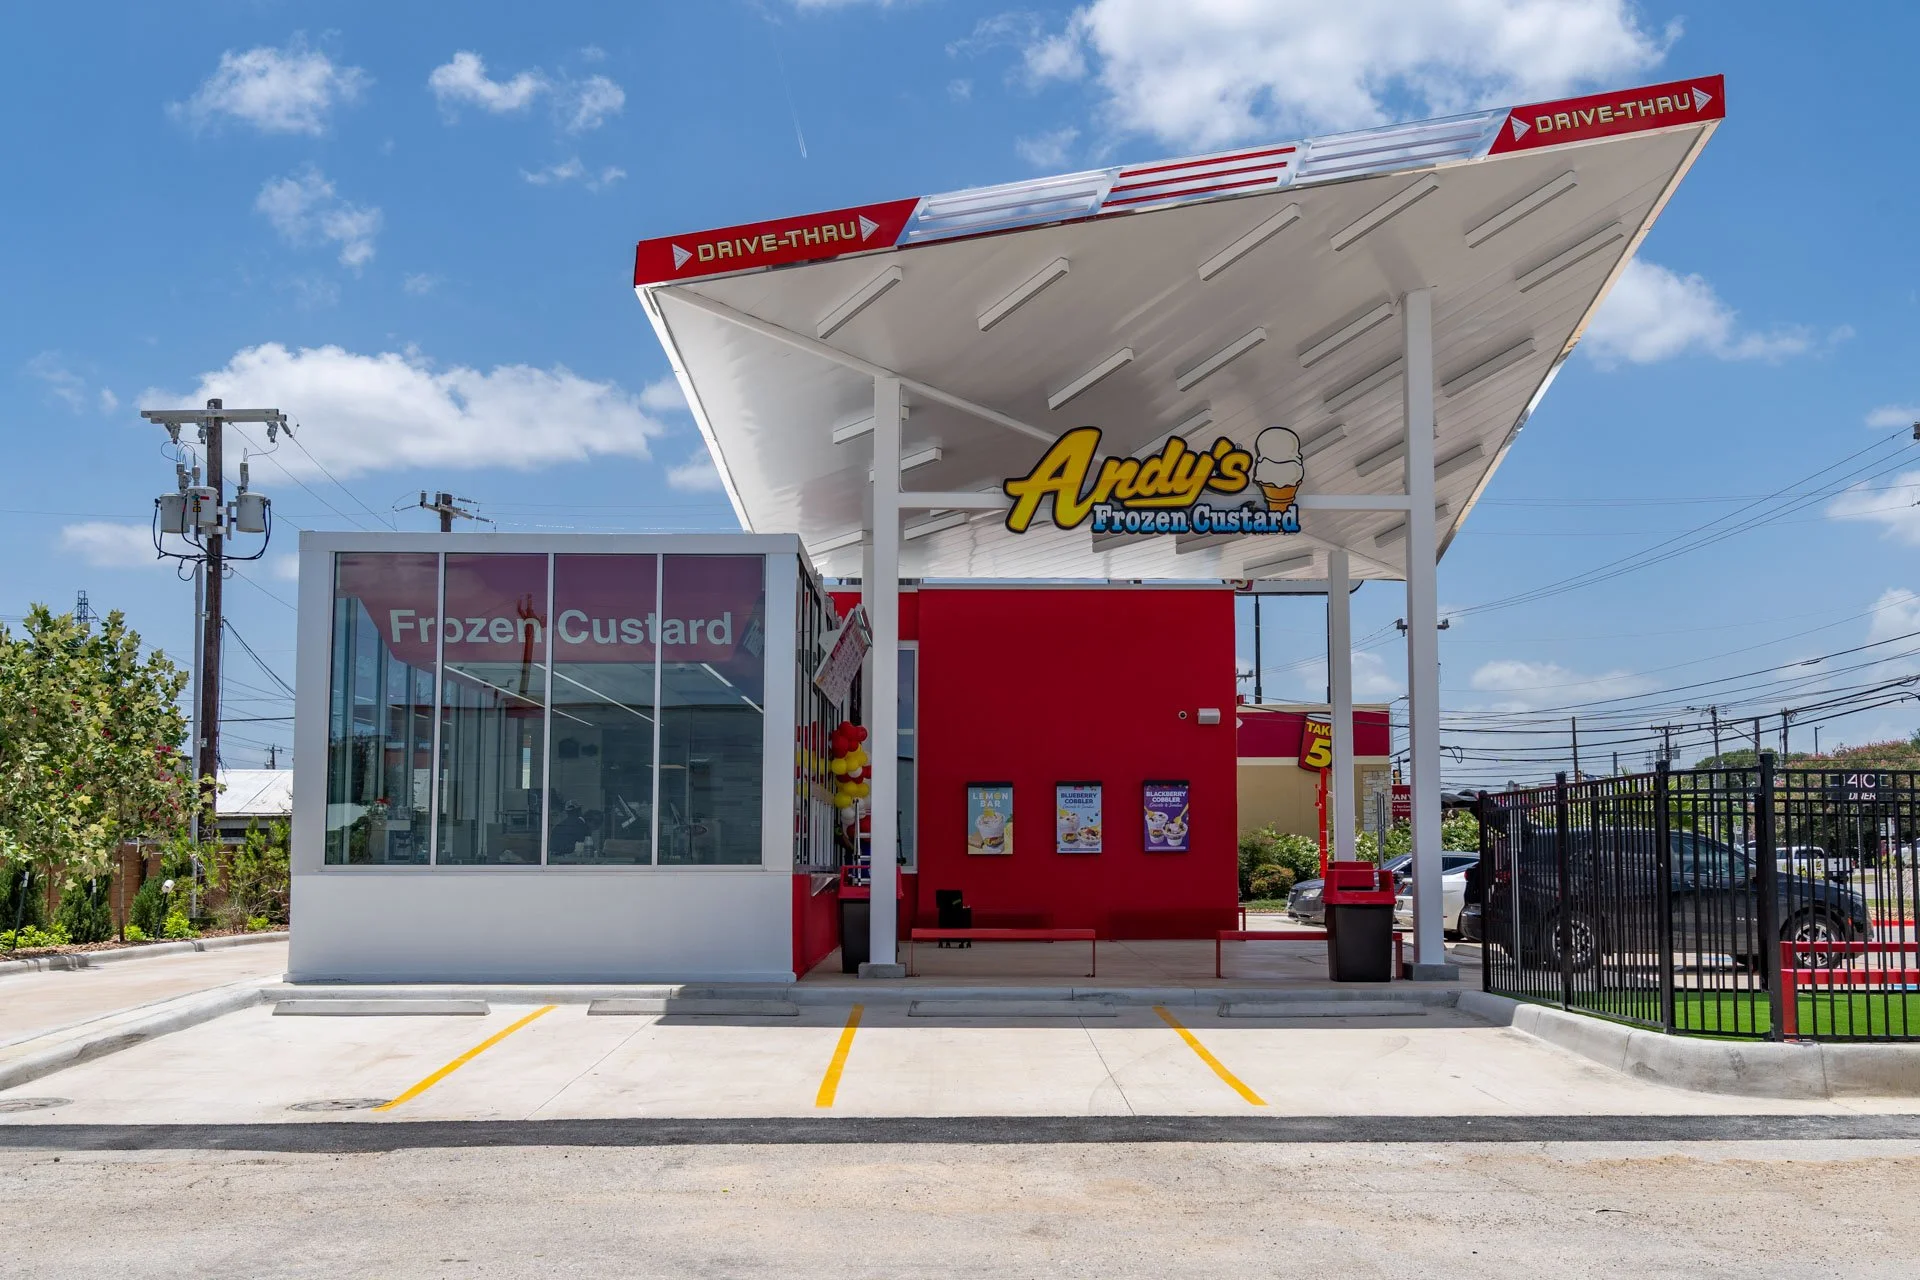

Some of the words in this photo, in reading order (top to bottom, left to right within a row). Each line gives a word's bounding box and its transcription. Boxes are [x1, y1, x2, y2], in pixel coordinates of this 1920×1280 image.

[1535, 92, 1690, 134] DRIVE-THRU
[697, 221, 857, 262] DRIVE-THRU
[1003, 426, 1254, 534] Andy's
[1091, 503, 1191, 534] Frozen
[1192, 502, 1301, 534] Custard
[389, 609, 542, 644] Frozen
[557, 609, 733, 645] Custard
[1306, 721, 1332, 736] TAK
[1305, 737, 1332, 767] 5
[972, 792, 1008, 800] LEMON
[980, 800, 1001, 808] BAR
